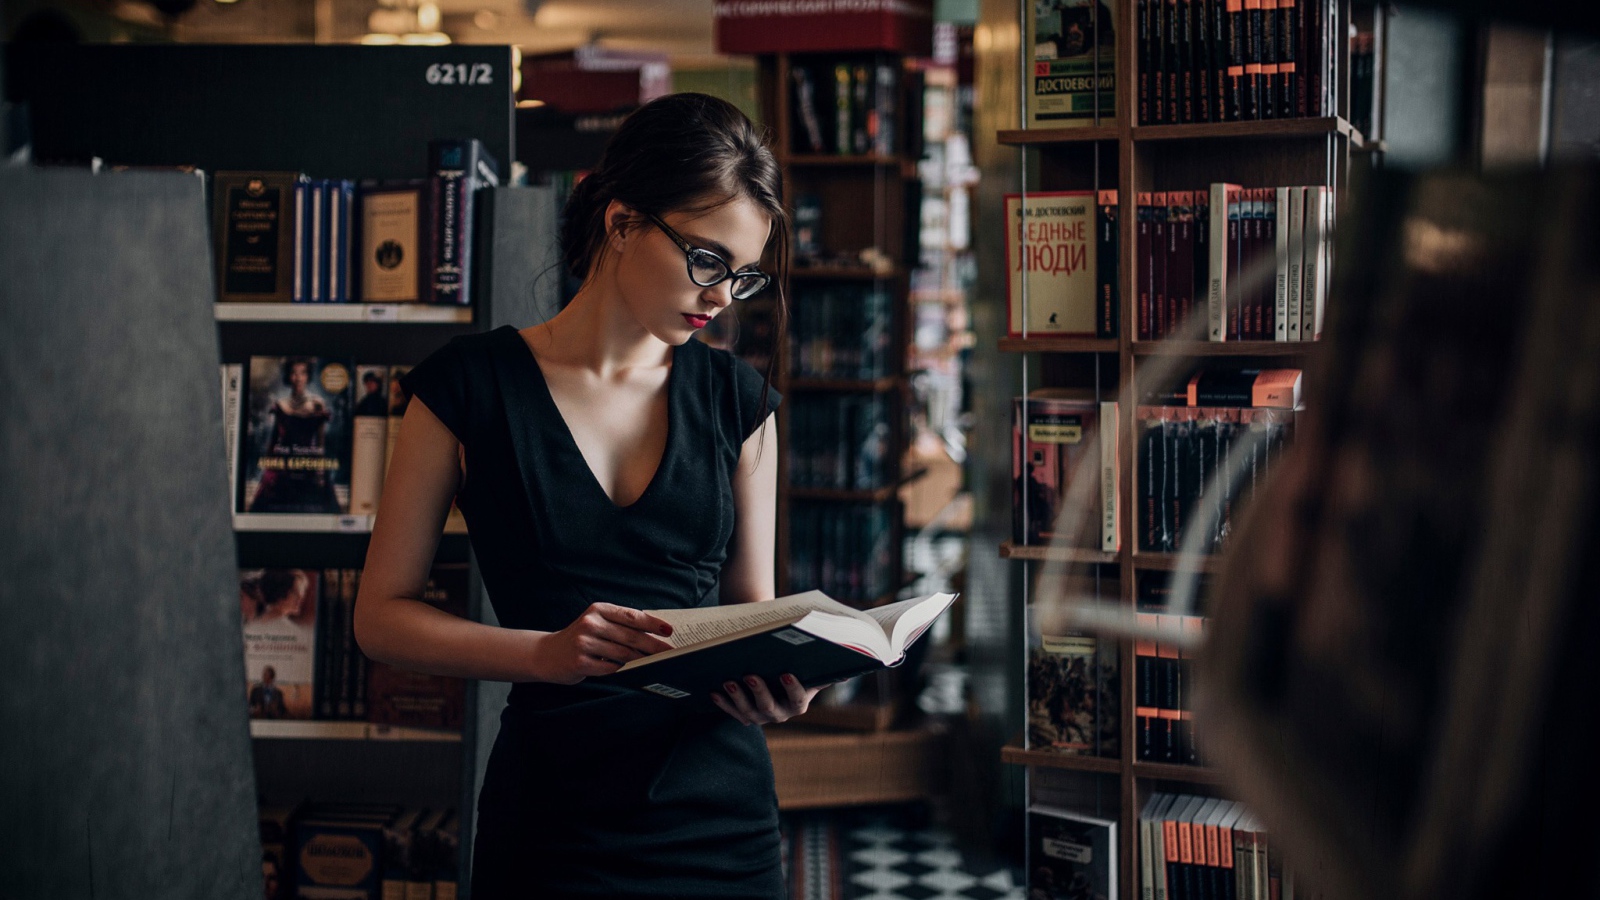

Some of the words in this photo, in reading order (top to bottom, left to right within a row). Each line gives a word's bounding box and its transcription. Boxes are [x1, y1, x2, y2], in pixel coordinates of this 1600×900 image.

[425, 62, 493, 86] 621/2
[1035, 205, 1086, 218] ДОСТОЕВСКИЙ
[1017, 221, 1086, 243] БЕДНЫЕ
[1016, 243, 1087, 277] ЛЮДИ
[1291, 264, 1299, 302] КОРОЛЕНКО
